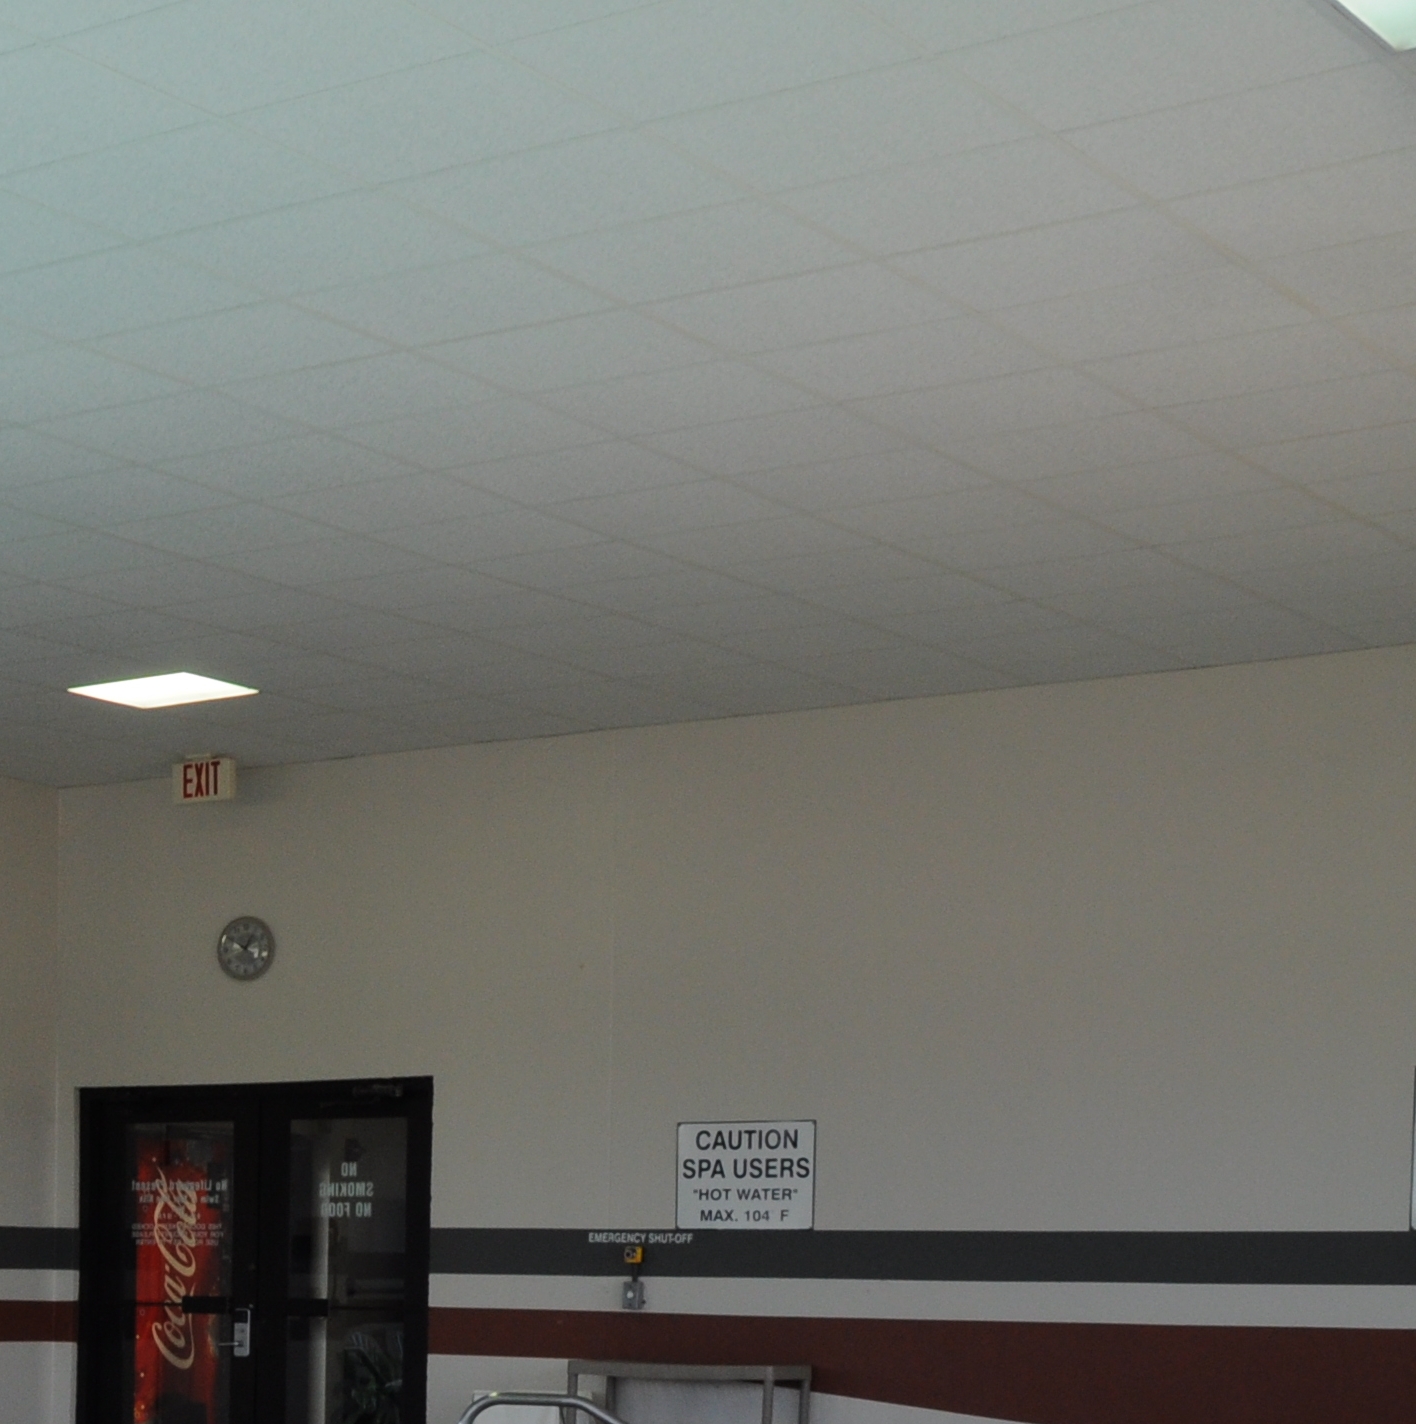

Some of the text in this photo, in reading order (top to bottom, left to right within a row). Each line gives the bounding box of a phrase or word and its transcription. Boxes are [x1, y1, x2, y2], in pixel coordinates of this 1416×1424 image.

[183, 761, 221, 798] EXIT
[696, 1129, 799, 1151] CAUTION
[683, 1157, 810, 1179] SPA USERS
[700, 1209, 790, 1222] MAX. 104 F
[588, 1232, 694, 1244] EMERGENCY SHUT-OFF
